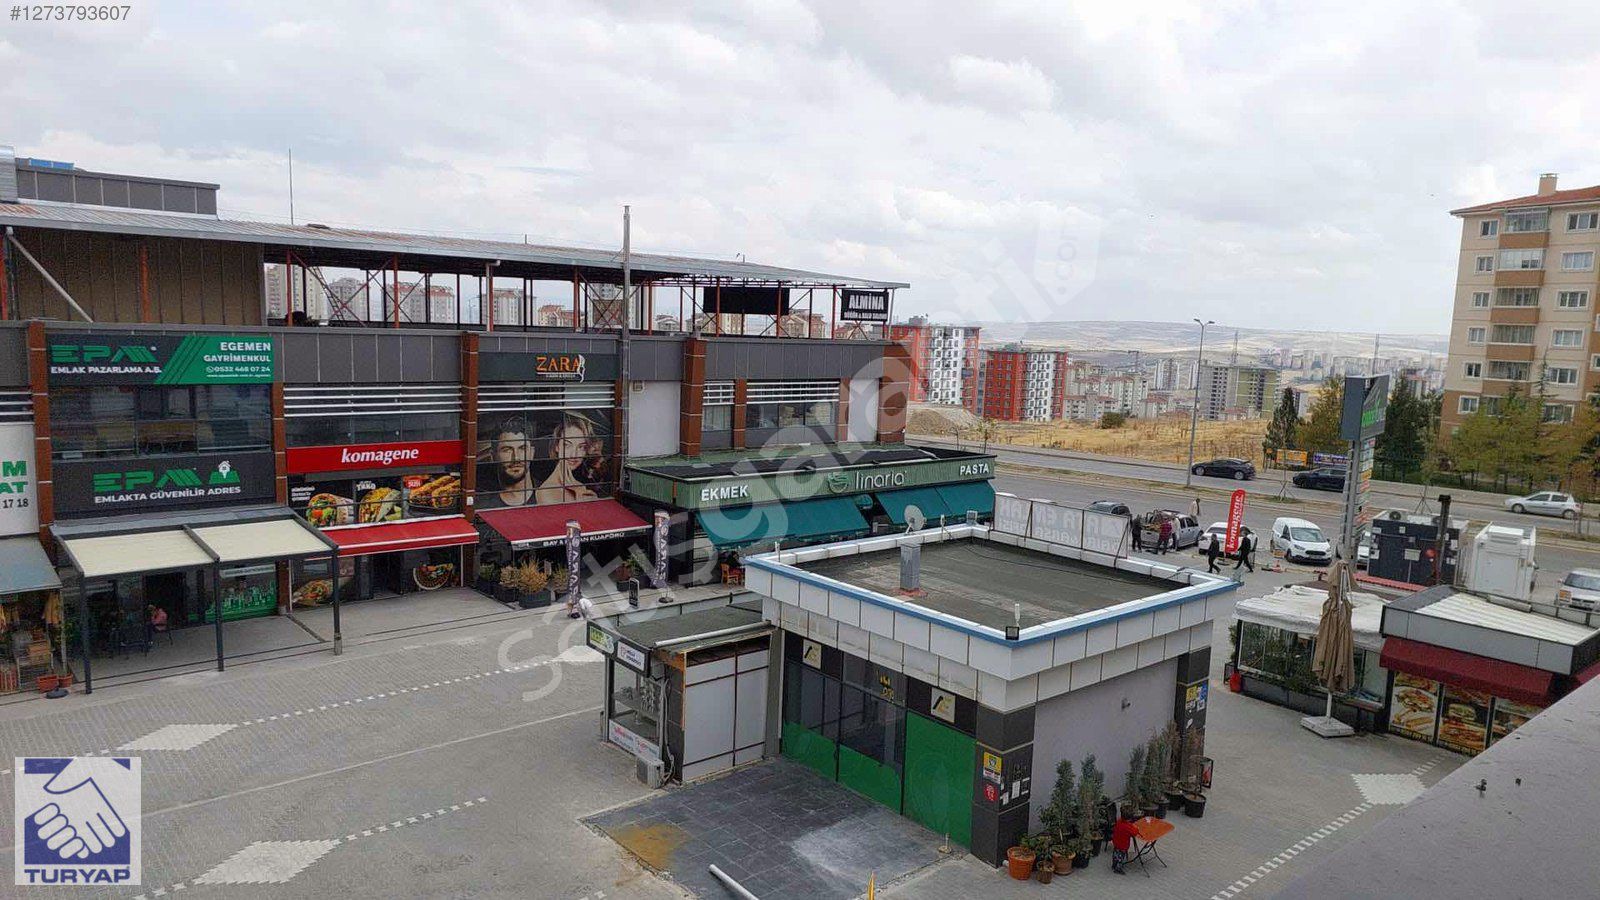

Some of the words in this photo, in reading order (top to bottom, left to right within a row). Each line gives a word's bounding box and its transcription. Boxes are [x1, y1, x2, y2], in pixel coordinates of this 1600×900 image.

[220, 342, 271, 351] EGEMEN
[203, 353, 271, 362] GAYRİMENKUL
[536, 356, 580, 371] ZARA
[51, 366, 86, 374] EMLAK
[88, 366, 143, 374] PAZARLAMA
[341, 447, 419, 465] komagene
[960, 463, 990, 476] PASTA
[856, 471, 905, 490] linaria
[95, 493, 147, 504] EMLAKTA
[149, 488, 205, 499] GÜVENİLİR
[207, 486, 242, 496] ADRES
[701, 484, 748, 501] EKMEK
[3, 499, 14, 508] 17
[17, 498, 29, 507] 18
